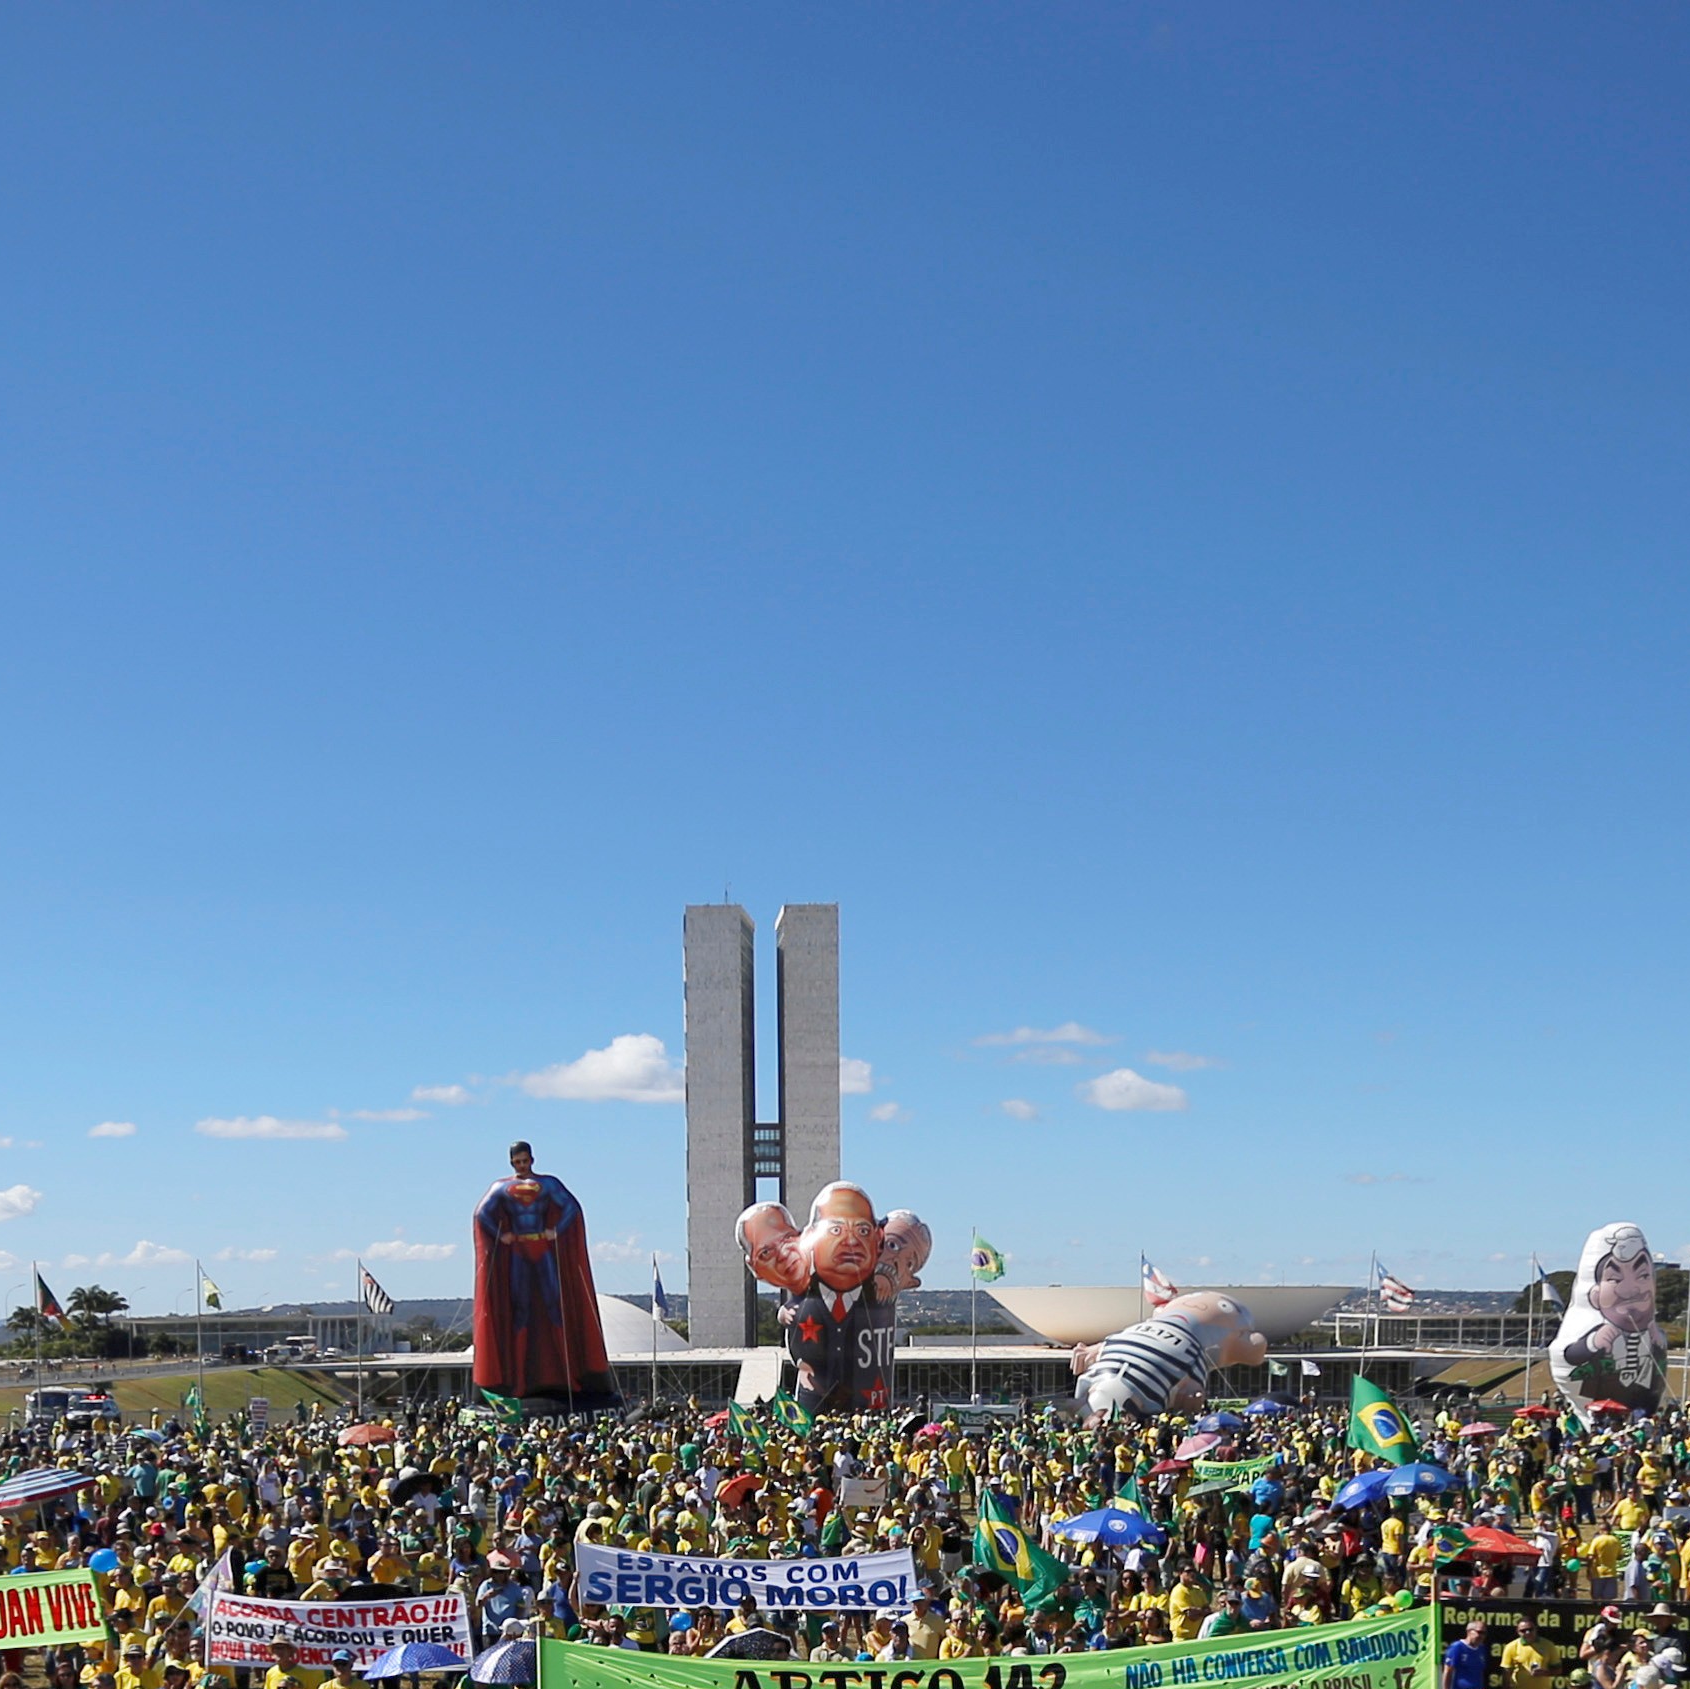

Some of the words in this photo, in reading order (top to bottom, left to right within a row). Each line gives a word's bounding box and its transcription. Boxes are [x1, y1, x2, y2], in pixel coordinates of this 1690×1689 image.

[858, 1327, 894, 1369] STF
[871, 1390, 884, 1405] PT
[617, 1553, 767, 1583] ESTAMOS
[786, 1561, 859, 1584] COM
[586, 1571, 751, 1606] SERGIO
[765, 1575, 908, 1608] MORO!
[45, 1582, 102, 1631] VIVE
[306, 1598, 459, 1629] CENTRÃO!!!
[1443, 1606, 1523, 1627] Reforma
[1537, 1609, 1560, 1628] da
[212, 1621, 223, 1636] O
[226, 1622, 263, 1638] POVO
[293, 1626, 374, 1646] ACORDOU
[383, 1630, 395, 1646] E
[401, 1625, 456, 1646] QUER
[211, 1640, 247, 1661] NOVA
[1203, 1647, 1288, 1681] CONVERSA
[1294, 1640, 1333, 1671] COM
[1339, 1624, 1429, 1667] BANDIDOS!
